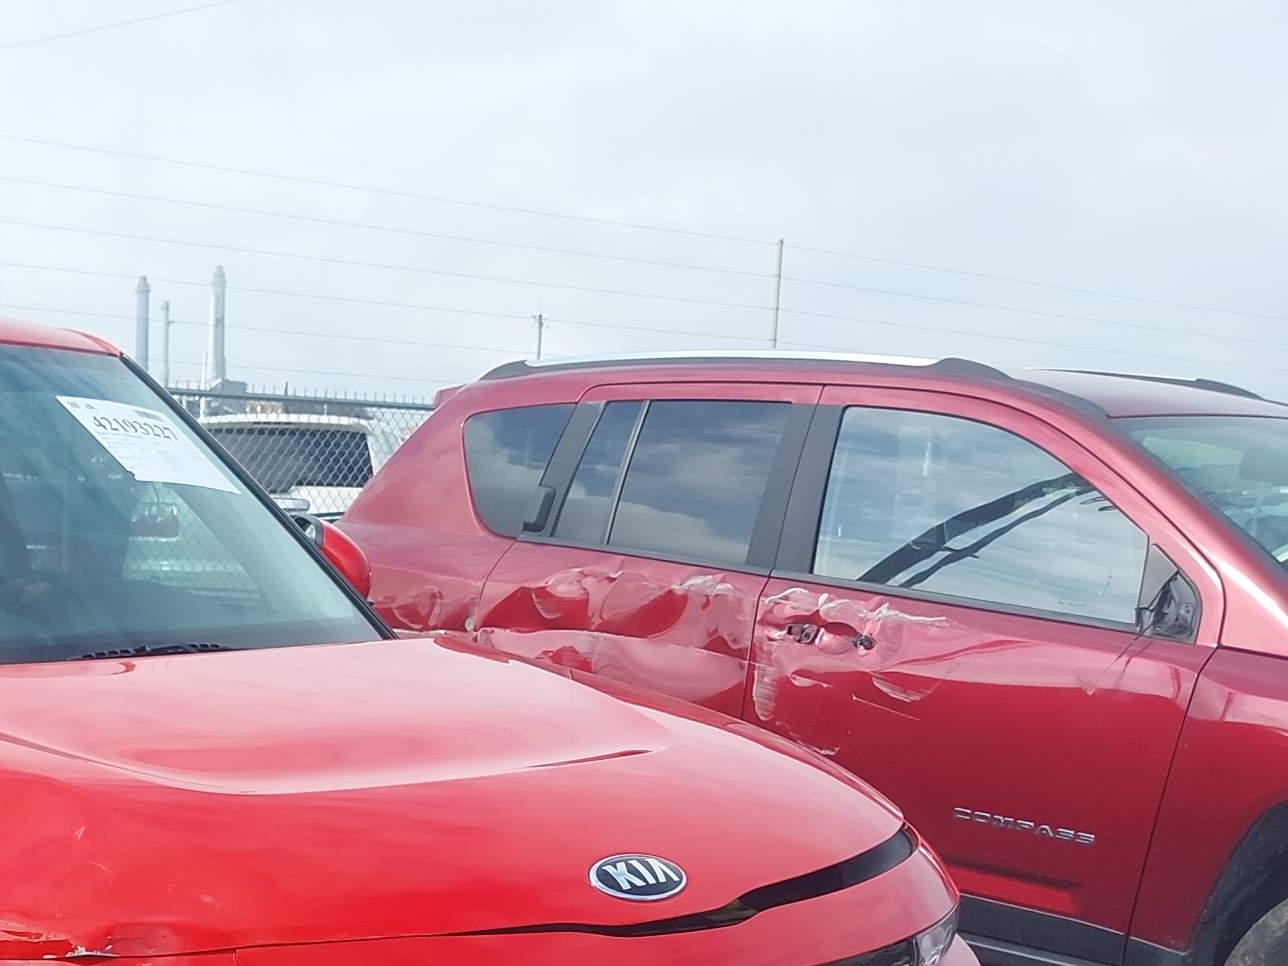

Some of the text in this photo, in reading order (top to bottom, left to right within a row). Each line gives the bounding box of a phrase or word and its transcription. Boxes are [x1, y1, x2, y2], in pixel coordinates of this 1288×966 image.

[92, 415, 179, 441] 42193227
[952, 806, 1096, 846] COMPASS
[601, 858, 680, 890] KIA
